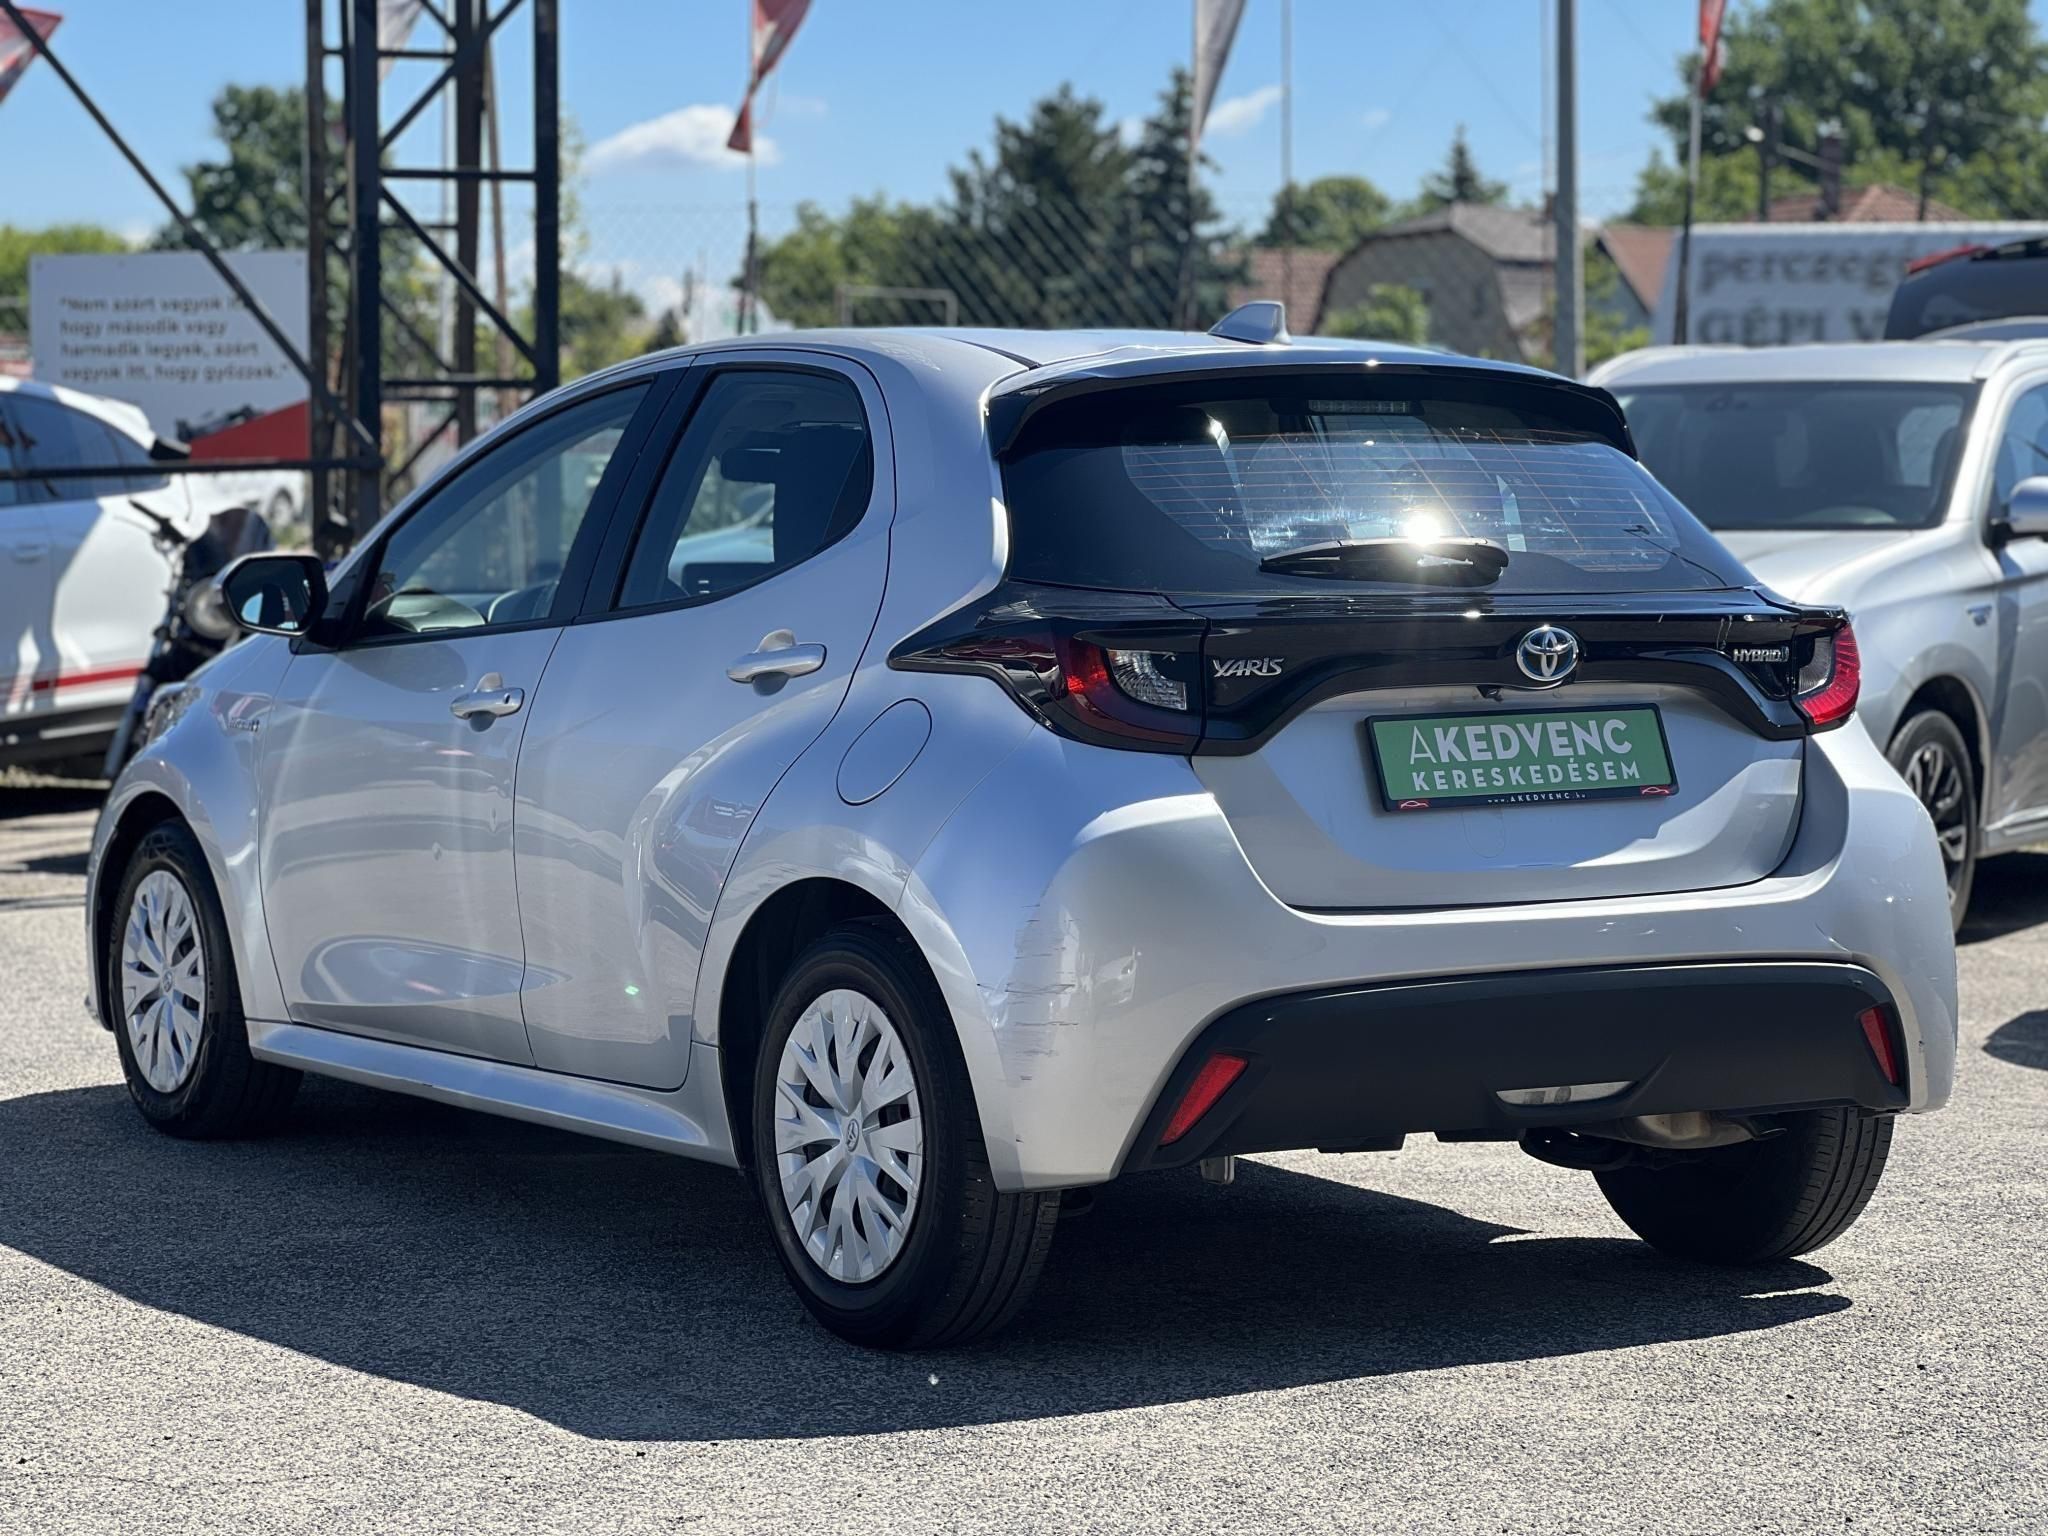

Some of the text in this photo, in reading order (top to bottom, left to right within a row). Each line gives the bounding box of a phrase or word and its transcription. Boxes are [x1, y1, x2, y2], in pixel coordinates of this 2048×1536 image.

[1695, 248, 1910, 296] perczeg
[1212, 657, 1285, 677] YARIS
[1732, 648, 1782, 662] HYBRID
[1411, 757, 1641, 791] KERESKEDÉSEM
